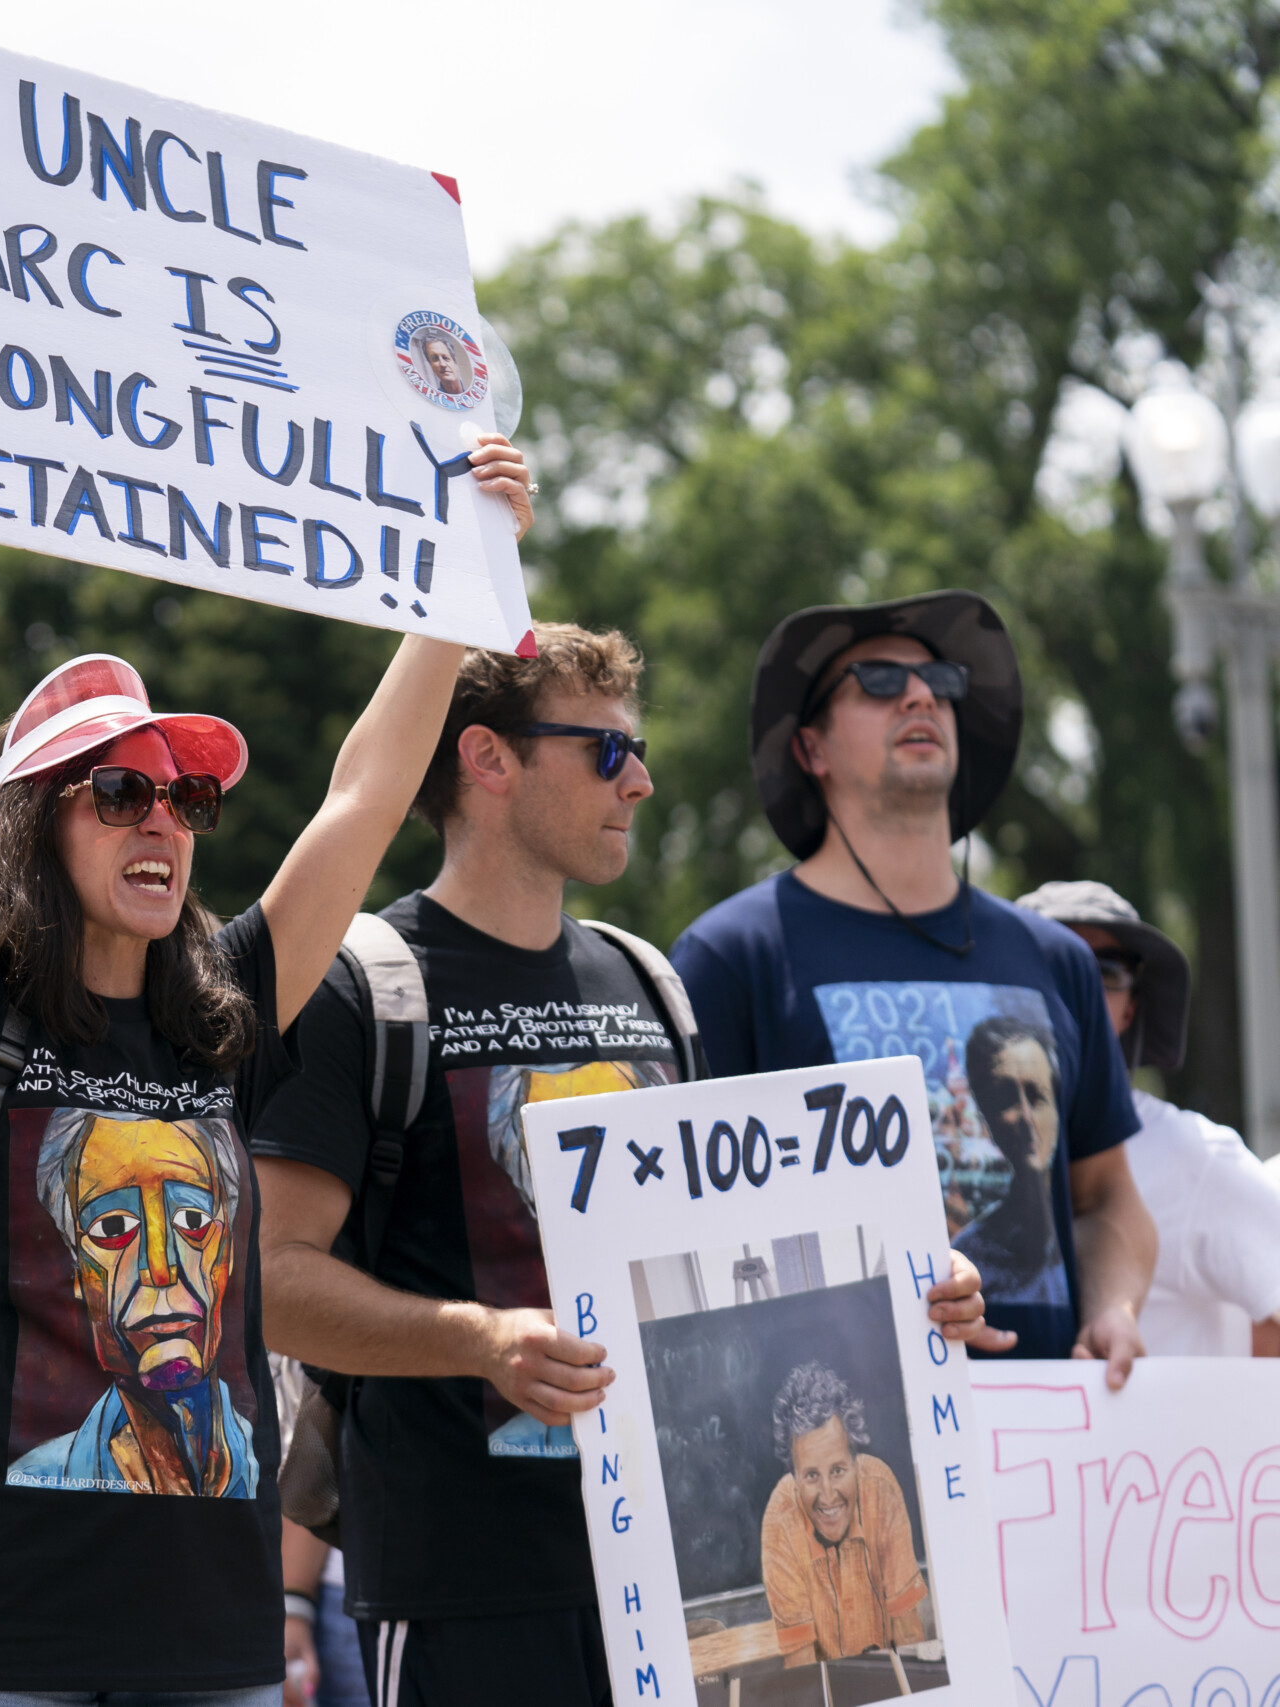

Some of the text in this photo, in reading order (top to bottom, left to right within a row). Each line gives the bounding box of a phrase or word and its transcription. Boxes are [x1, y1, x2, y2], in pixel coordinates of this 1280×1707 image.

[19, 80, 308, 252] UNCLE
[165, 265, 283, 355] IS
[400, 311, 467, 340] FREEDOM
[402, 363, 488, 410] MARC FOGEL
[445, 1001, 639, 1024] I'M A SON/HUSBAND/
[831, 988, 959, 1036] 2021
[428, 1015, 665, 1042] FATHER/ BROTHER/ FRIEND
[440, 1030, 674, 1057] AND A 40 YEAR EDUCATOR
[17, 1079, 52, 1092] AND
[86, 1086, 169, 1111] BROTHER/
[177, 1086, 231, 1112] FRIEND
[557, 1125, 607, 1214] 7
[907, 1250, 966, 1500] HOME
[488, 1438, 580, 1456] @ENGELHARD
[7, 1470, 150, 1490] @ENGELHARDTDESIGNS
[575, 1293, 661, 1699] BING HIM
